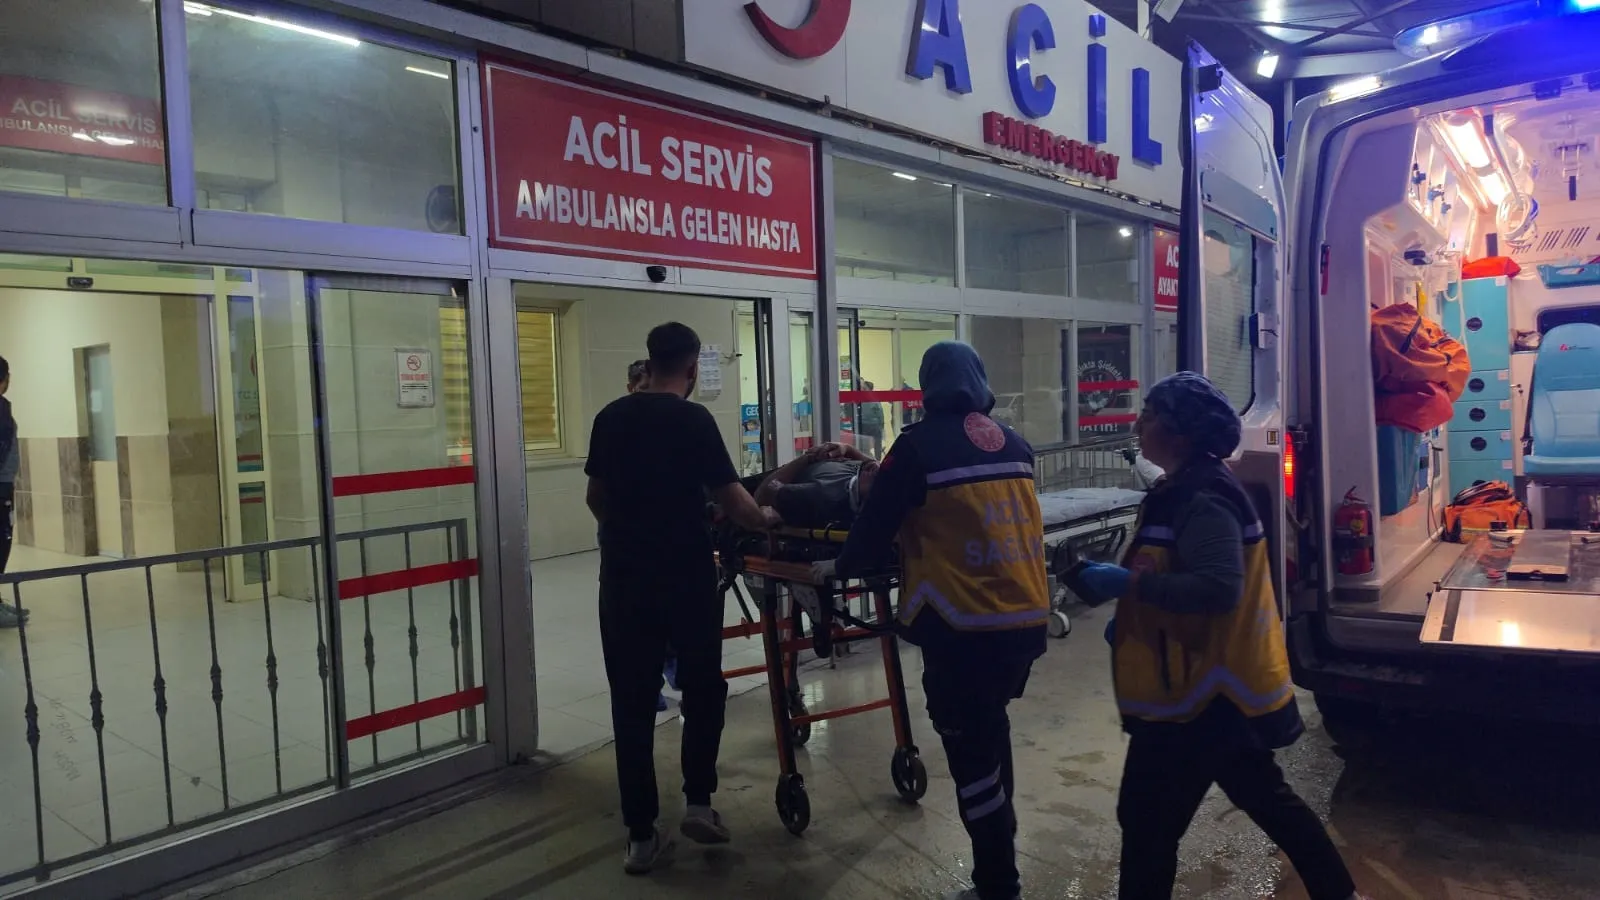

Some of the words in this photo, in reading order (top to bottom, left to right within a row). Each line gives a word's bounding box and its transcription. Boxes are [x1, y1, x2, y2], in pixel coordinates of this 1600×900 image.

[11, 97, 70, 120] ACİL
[564, 114, 651, 176] ACİL
[661, 135, 773, 198] SERVİS
[983, 111, 1120, 180] EMERGENCY
[515, 179, 676, 238] AMBULANSLA
[681, 206, 742, 247] GELEN
[747, 215, 801, 254] HASTA
